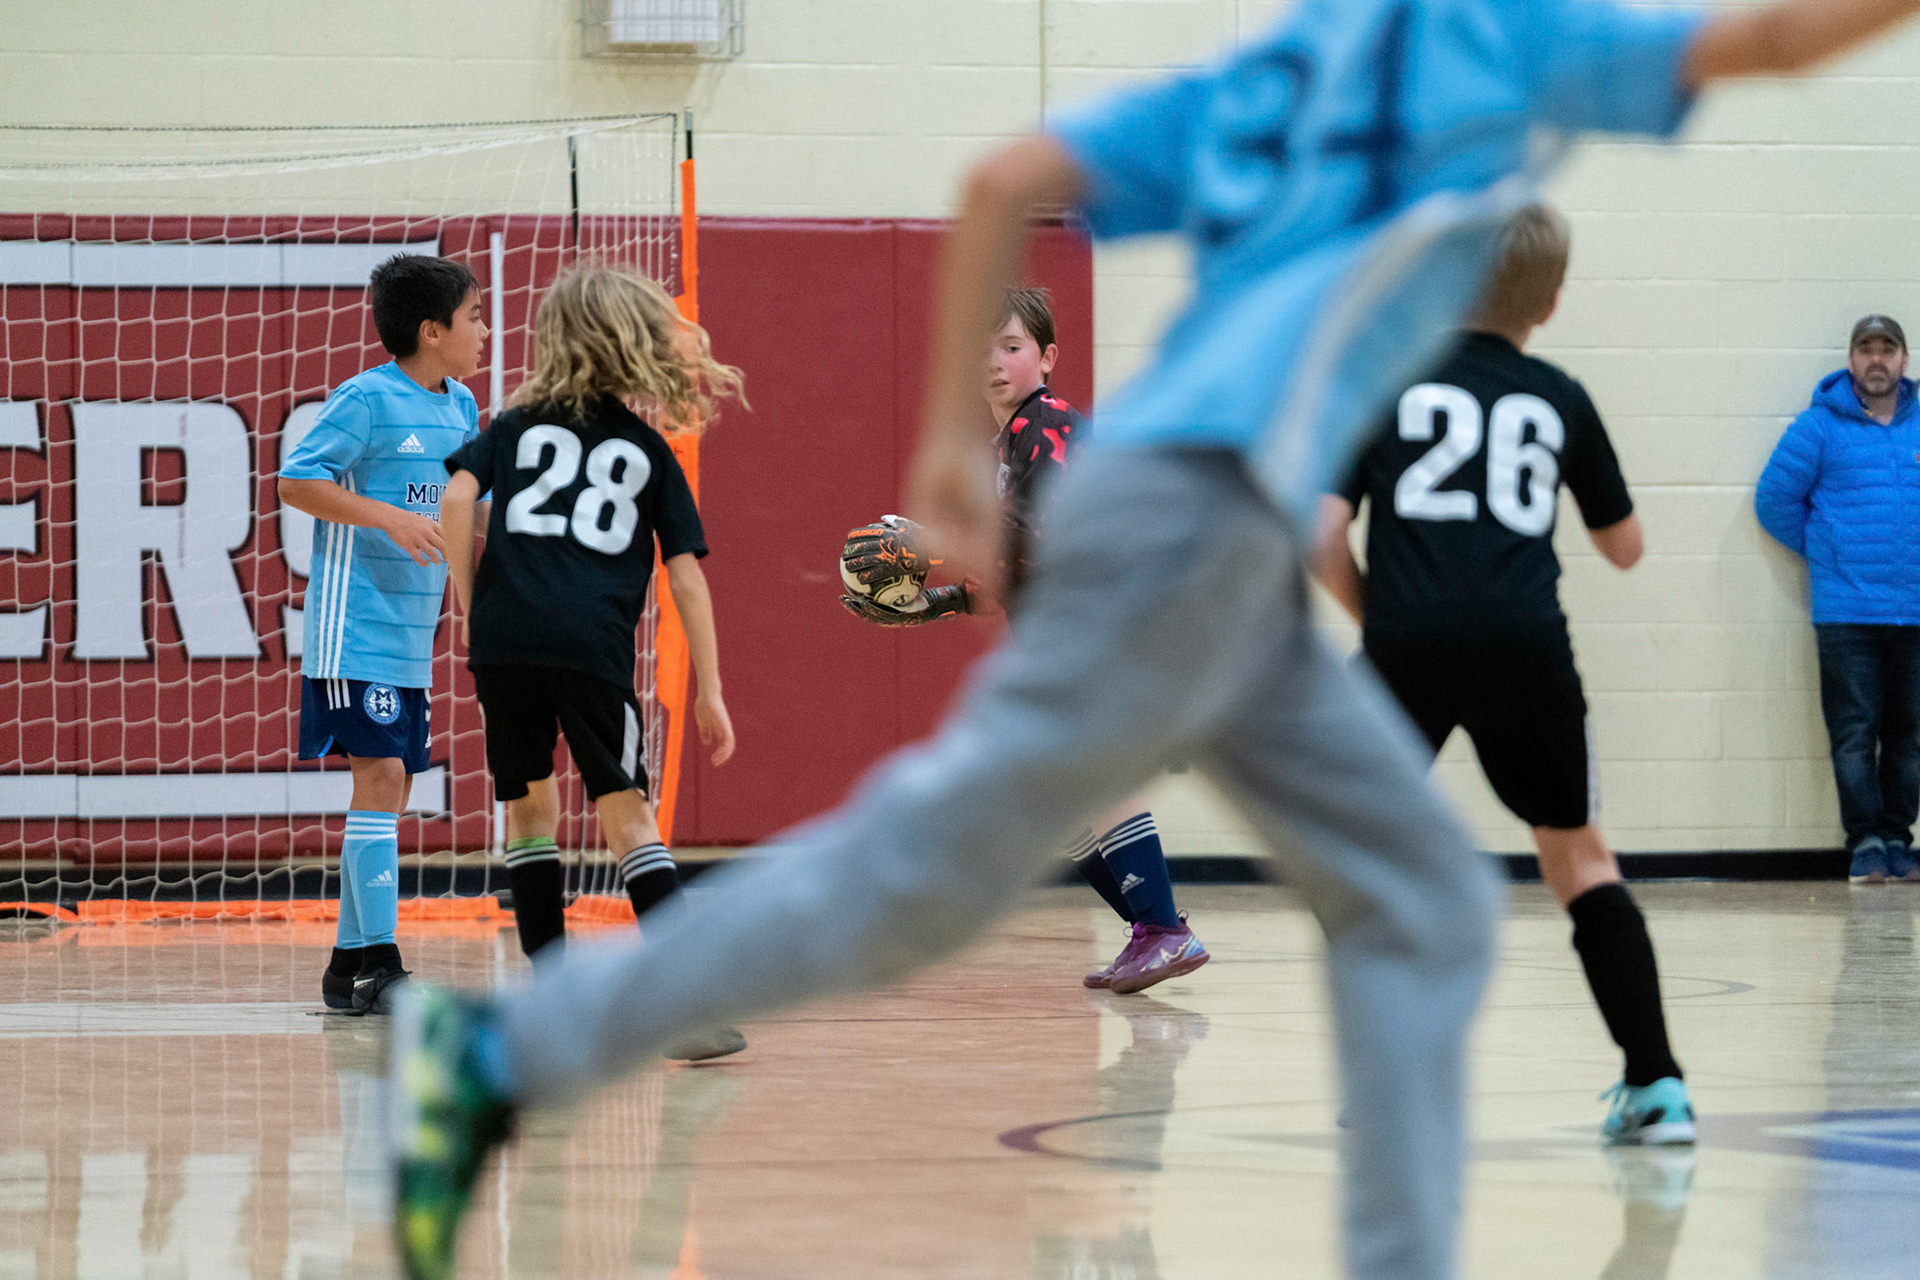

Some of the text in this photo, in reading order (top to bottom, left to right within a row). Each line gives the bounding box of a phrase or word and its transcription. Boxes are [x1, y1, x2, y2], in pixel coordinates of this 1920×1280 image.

[397, 445, 425, 454] adidas
[505, 425, 652, 555] 28
[1394, 382, 1565, 538] 26
